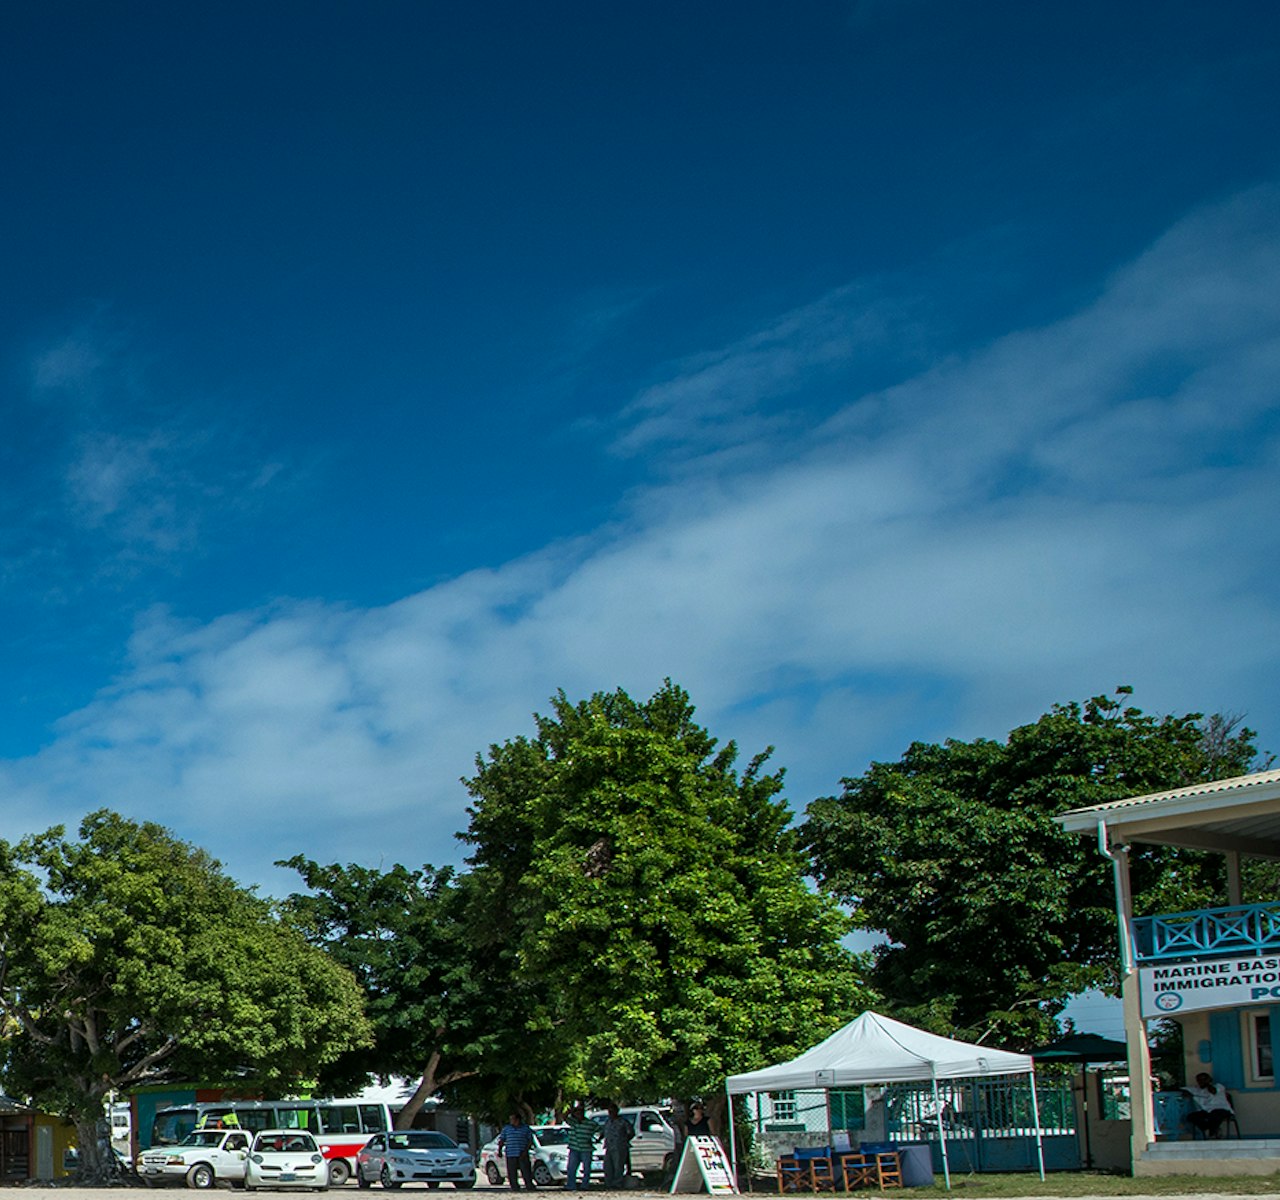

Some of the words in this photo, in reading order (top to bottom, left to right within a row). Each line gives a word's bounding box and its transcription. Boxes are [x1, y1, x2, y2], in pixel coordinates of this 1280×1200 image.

[1153, 963, 1231, 979] MARINE
[1237, 959, 1280, 972] BAS
[1153, 972, 1280, 992] IMMIGRATIO
